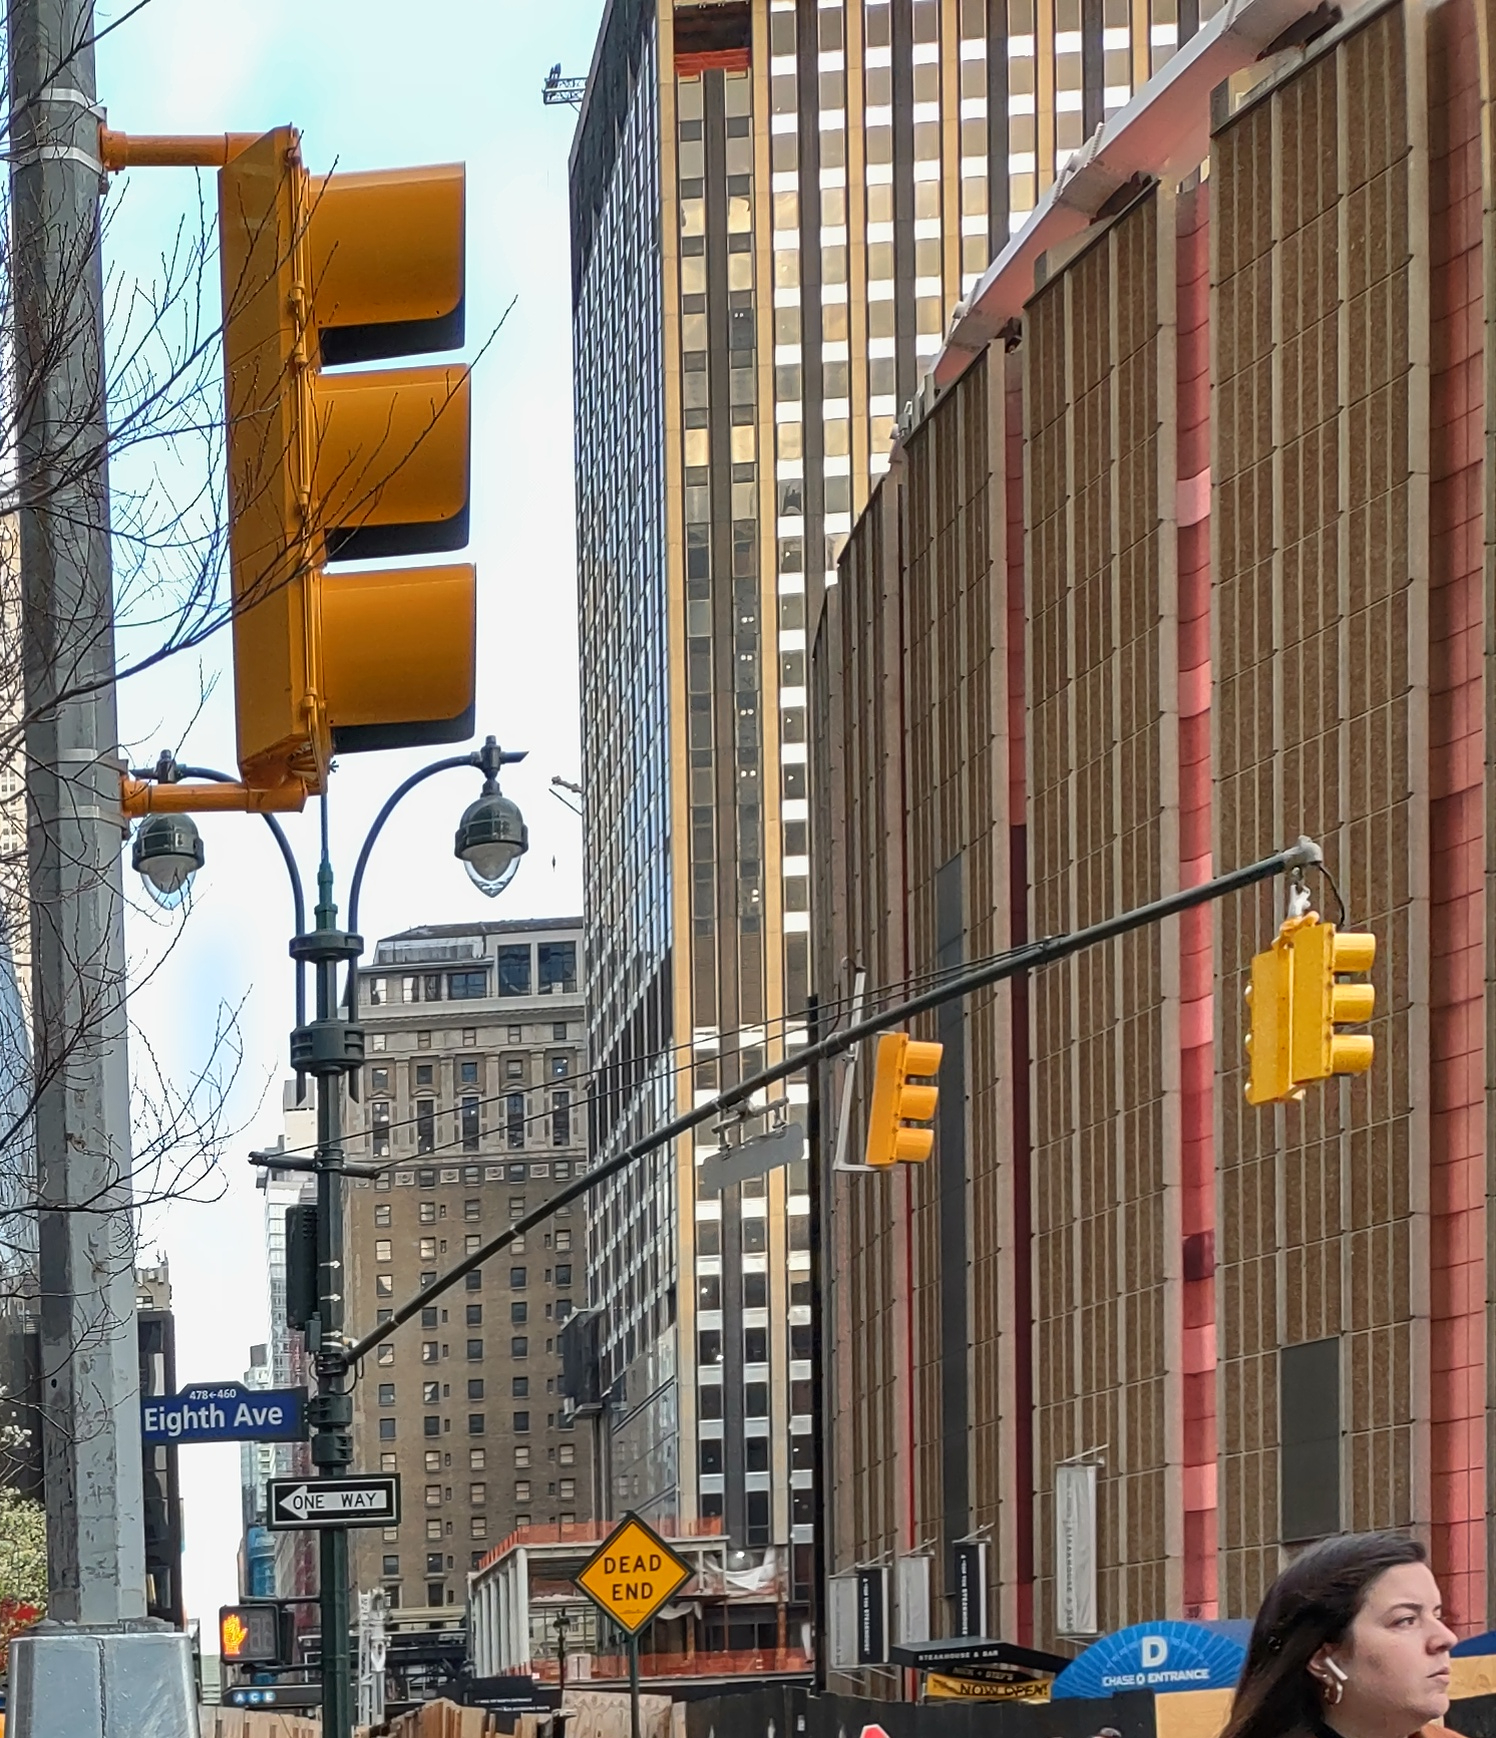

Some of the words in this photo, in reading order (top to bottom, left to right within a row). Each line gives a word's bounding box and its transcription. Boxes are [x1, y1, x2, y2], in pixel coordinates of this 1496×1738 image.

[144, 1403, 225, 1437] Eighth
[233, 1402, 283, 1427] Ave
[293, 1495, 324, 1510] ONE
[341, 1492, 377, 1507] WAY
[604, 1554, 662, 1574] DEAD
[612, 1582, 653, 1601] END
[918, 1651, 970, 1661] STEAKHOUSE
[982, 1650, 998, 1658] BAR
[1142, 1635, 1169, 1668] D
[1102, 1675, 1135, 1687] CHASE
[1148, 1668, 1210, 1684] ENTRANCE
[960, 1683, 998, 1696] NOW
[1004, 1683, 1049, 1697] OPEN!
